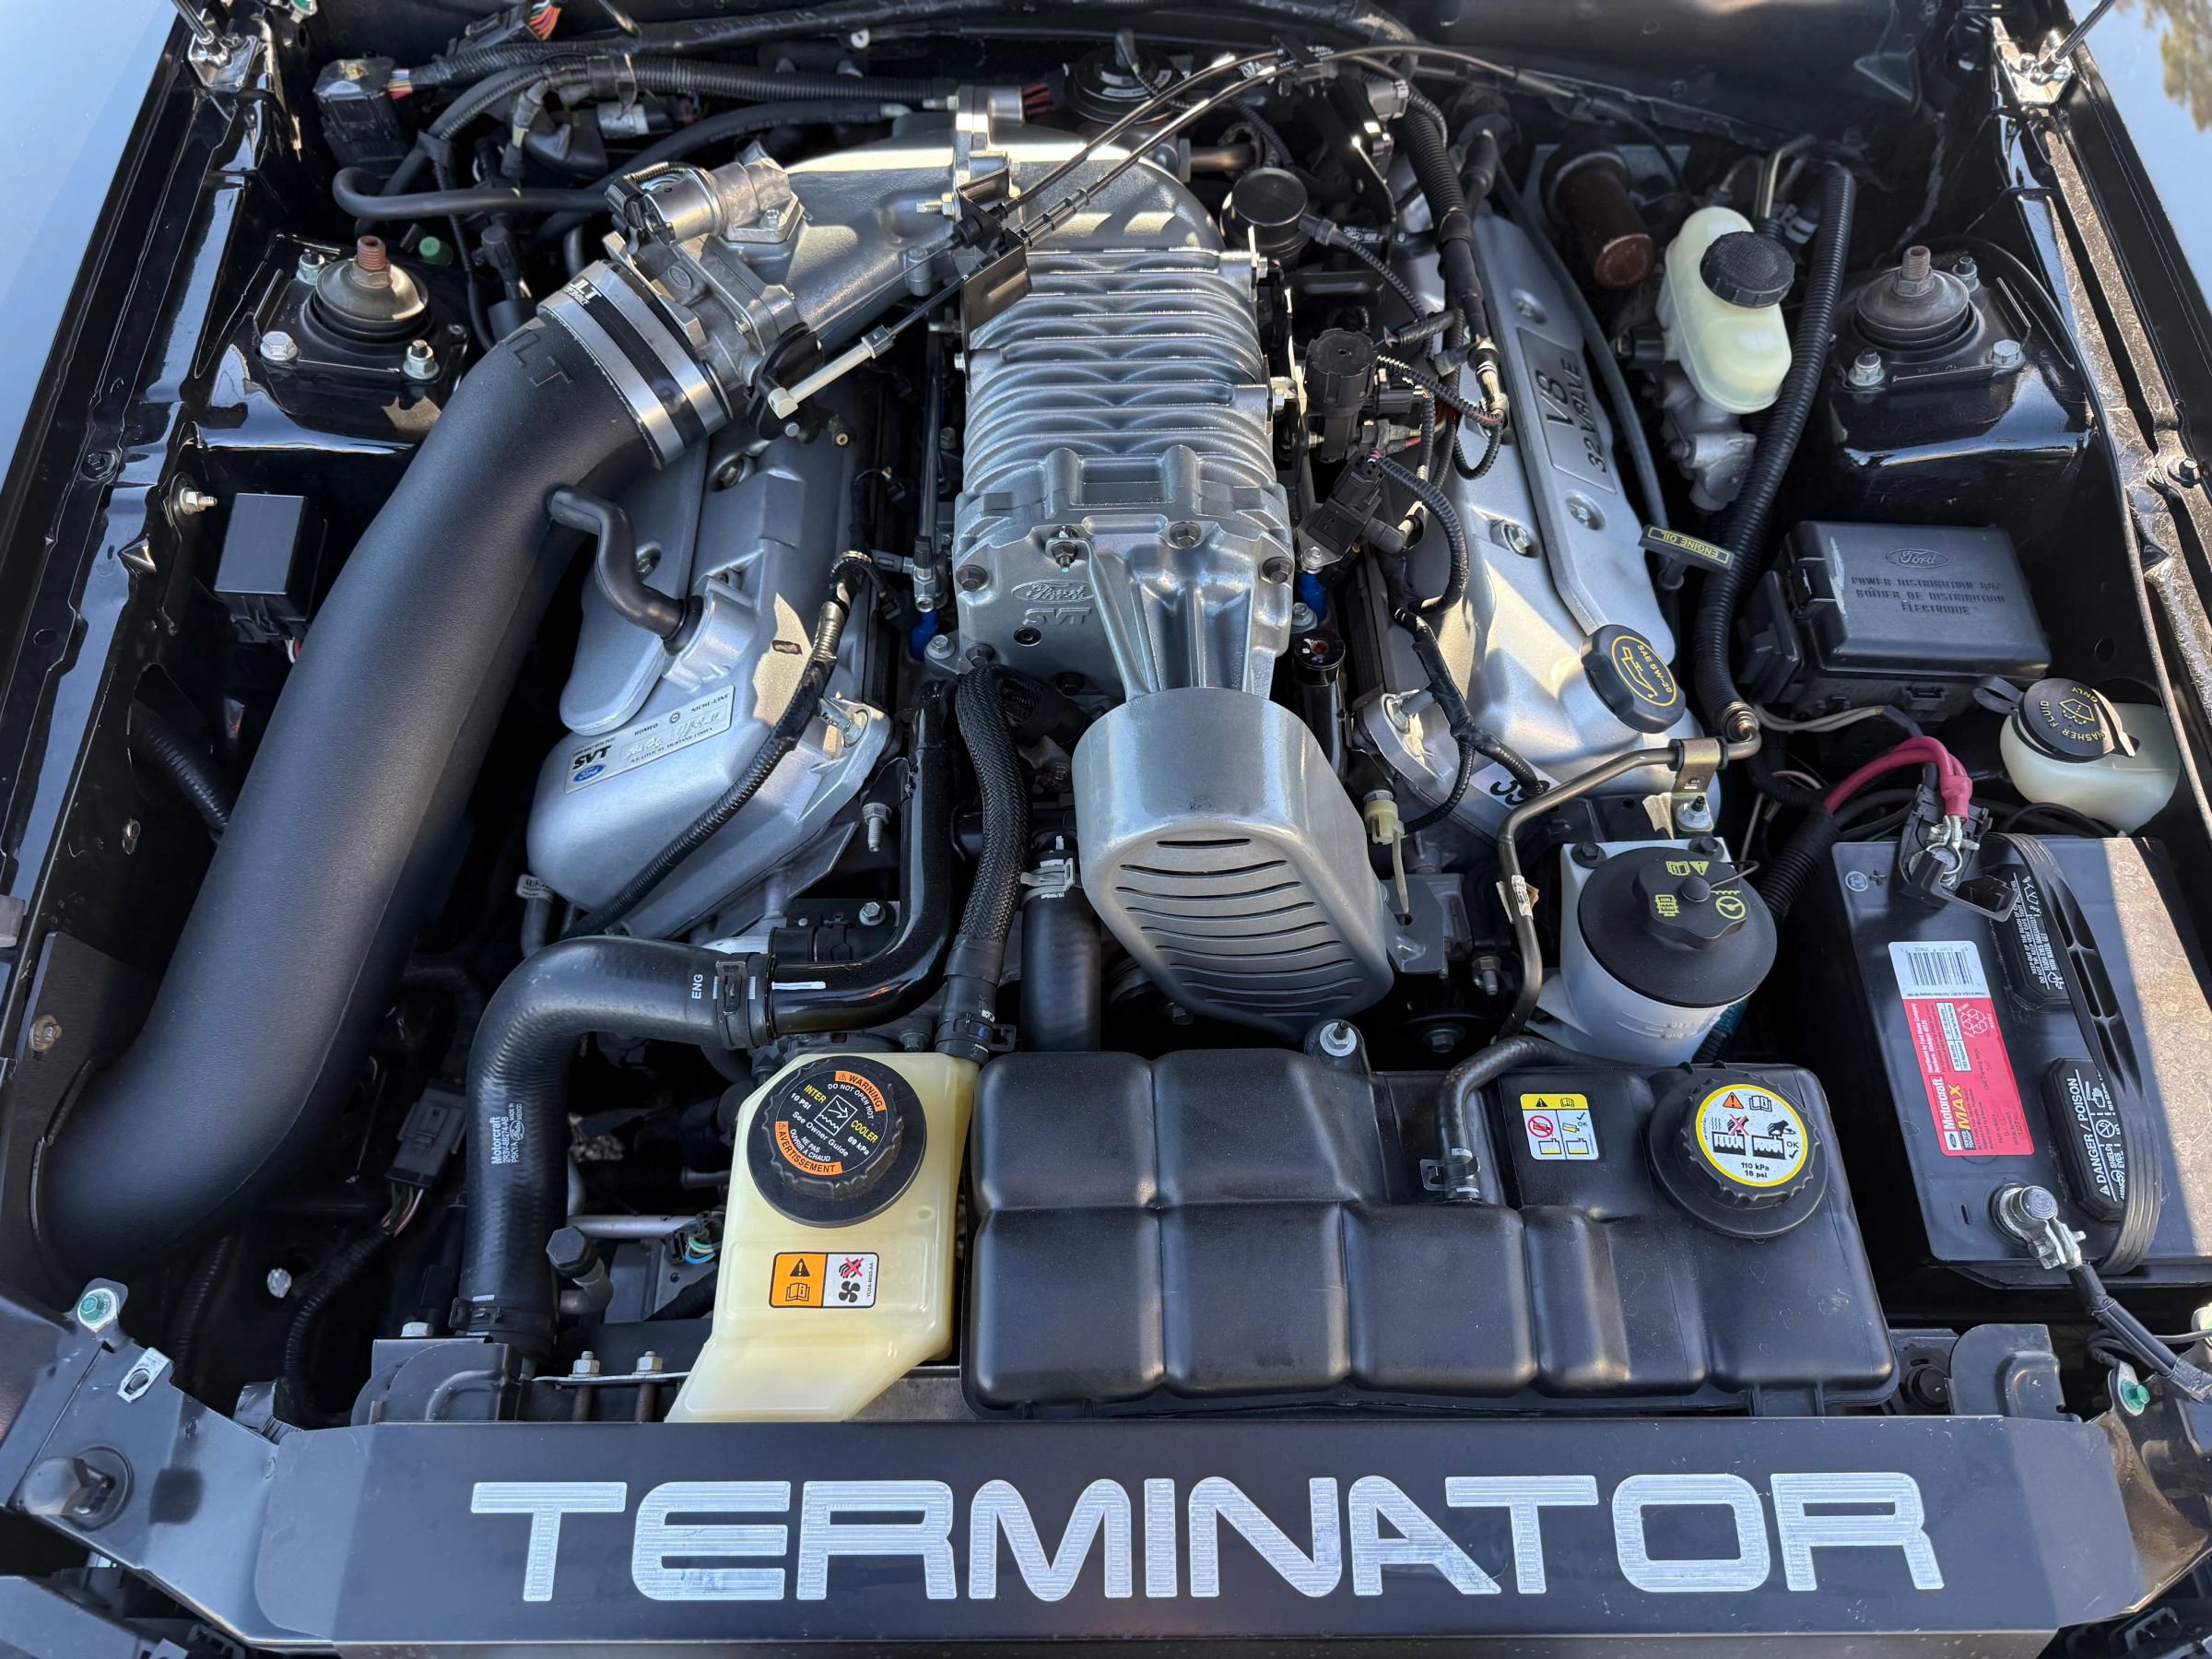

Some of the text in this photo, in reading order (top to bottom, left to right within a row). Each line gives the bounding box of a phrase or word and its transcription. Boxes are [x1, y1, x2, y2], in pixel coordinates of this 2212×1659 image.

[1535, 370, 1574, 428] V8
[1560, 358, 1606, 474] 32 VALVE
[1661, 531, 1719, 558] ENGINE OIL
[1907, 591, 1922, 600] DE
[1022, 607, 1091, 626] SVT
[1637, 644, 1673, 693] SAE 5W-20
[2072, 687, 2099, 703] ONLY
[2040, 700, 2107, 742] WASHER FLUID
[572, 745, 612, 770] SVT
[691, 973, 703, 1000] ENG
[791, 1092, 812, 1110] 10 PSI
[804, 1084, 827, 1104] INTER
[840, 1084, 855, 1092] NOT
[854, 1089, 869, 1106] OPEN
[865, 1105, 874, 1120] HOT
[849, 1074, 883, 1108] WARNING
[1932, 1077, 1954, 1130] Motorcraft
[2066, 1077, 2088, 1122] POISON
[1947, 1083, 1971, 1130] MAX
[489, 1116, 502, 1164] Motorcraft
[790, 1129, 805, 1151] OUVRIR
[808, 1152, 831, 1161] CHAUD
[792, 1111, 849, 1158] See Owner Guide
[801, 1136, 820, 1153] NE PAS
[847, 1135, 870, 1156] 69 kPa
[851, 1119, 879, 1144] COOLER
[1786, 1140, 1799, 1148] OK
[778, 1131, 836, 1173] AVERTISSEMENT
[2083, 1134, 2109, 1183] DANGER
[2106, 1147, 2116, 1169] SHIELD
[1754, 1163, 1770, 1172] kPa
[1756, 1171, 1768, 1180] psi
[470, 1475, 1944, 1603] TERMINATOR
